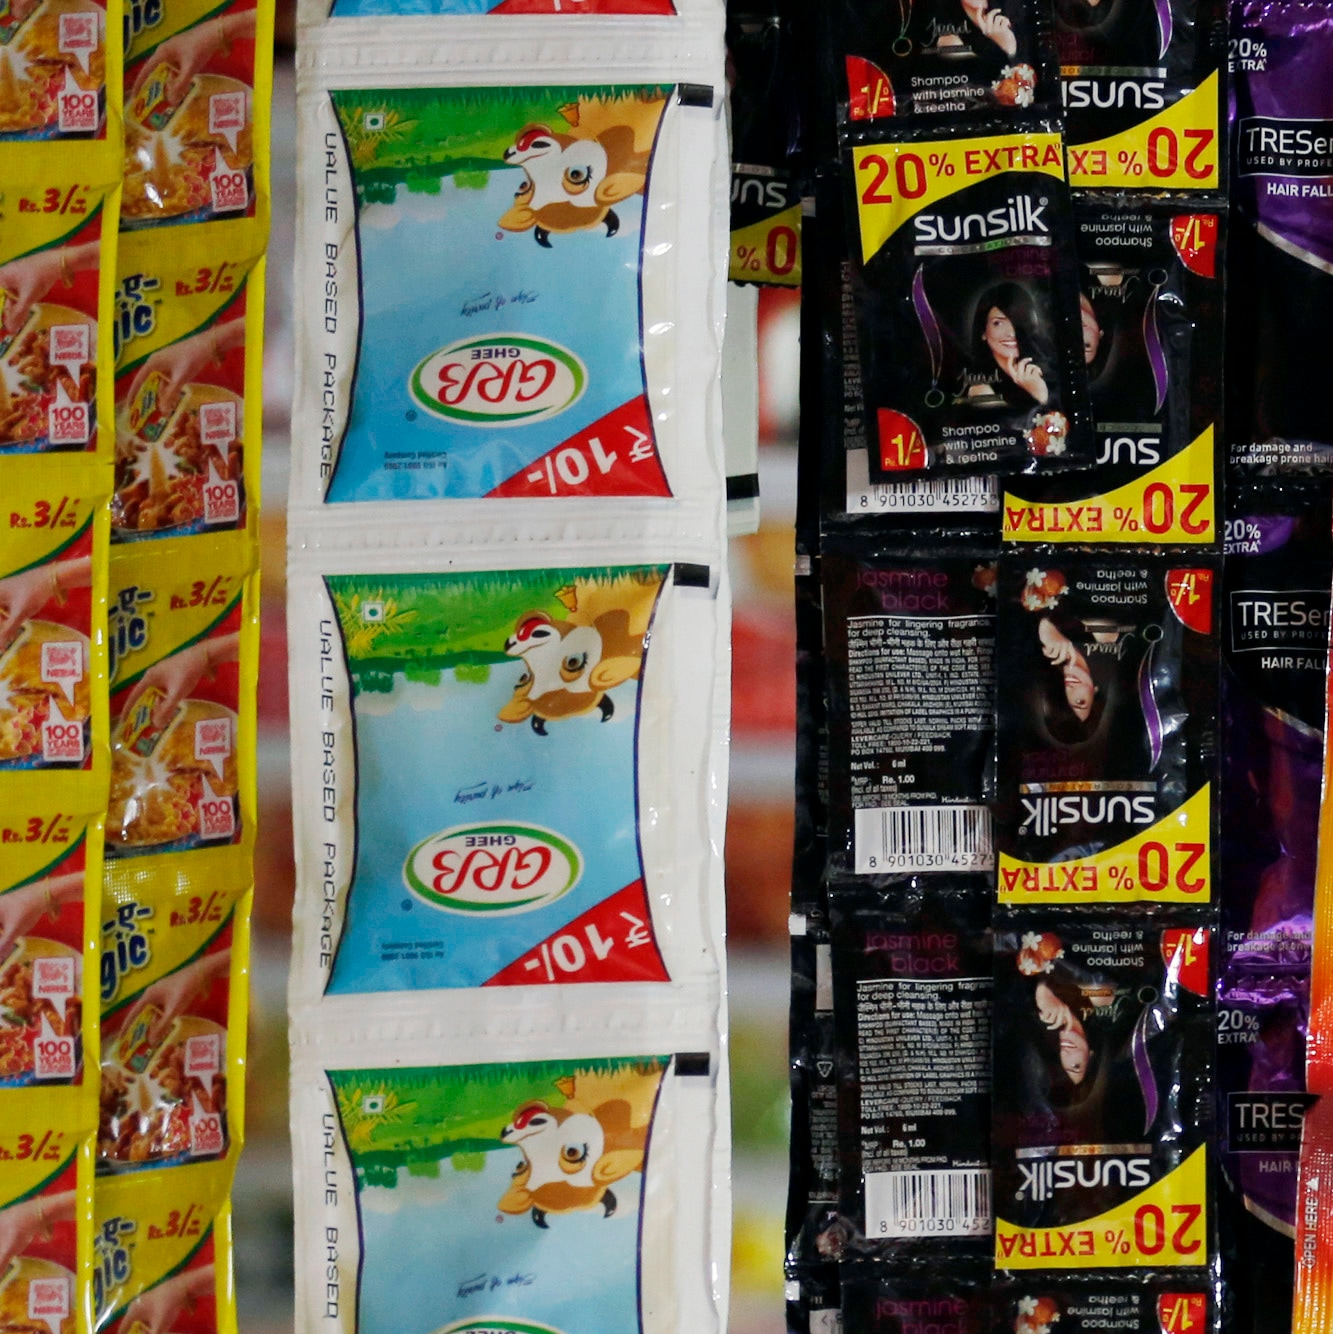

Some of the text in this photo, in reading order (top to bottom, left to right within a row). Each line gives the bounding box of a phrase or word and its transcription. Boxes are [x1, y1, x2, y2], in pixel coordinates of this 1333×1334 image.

[912, 75, 968, 89] Shampoo
[914, 88, 984, 102] with jasmine
[914, 102, 965, 113] & reetha
[859, 152, 955, 205] 20%
[1268, 184, 1333, 196] HAIR FALL
[324, 244, 338, 333] BASED
[471, 348, 520, 360] GHEE
[438, 361, 556, 405] GRB
[319, 354, 337, 479] PACKAGE
[942, 425, 1000, 437] Shampoo
[944, 436, 1016, 451] with jasmine
[1250, 443, 1290, 454] damage
[1292, 443, 1313, 452] and
[958, 452, 996, 464] reetha
[1114, 484, 1210, 534] 20%
[45, 725, 79, 740] 100
[322, 731, 335, 822] BASED
[465, 836, 515, 847] GHEE
[432, 847, 551, 894] GRB
[1108, 844, 1205, 892] 20%
[320, 843, 335, 969] PACKAGE
[1219, 1012, 1259, 1031] 20%
[1105, 1205, 1200, 1254] 20%
